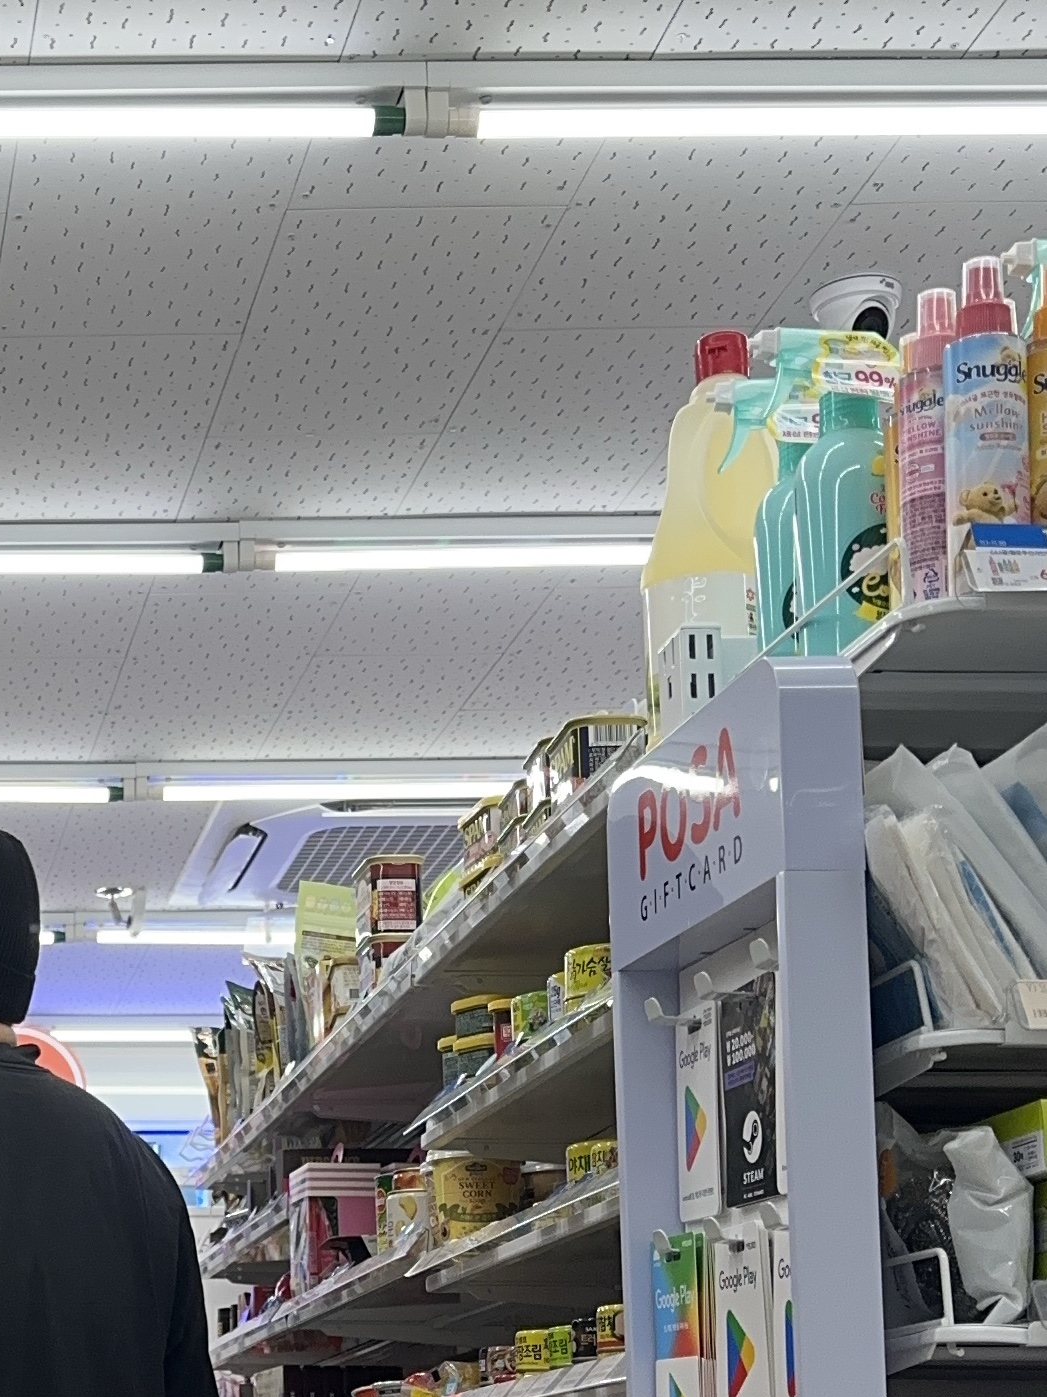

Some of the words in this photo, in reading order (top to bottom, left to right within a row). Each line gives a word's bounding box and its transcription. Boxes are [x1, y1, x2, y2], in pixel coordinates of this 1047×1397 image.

[679, 1049, 699, 1070] Google
[700, 1043, 712, 1066] Play
[458, 1182, 495, 1190] SWEET
[742, 1168, 764, 1184] STEAM
[462, 1189, 492, 1198] CORN
[719, 1271, 742, 1293] Google
[743, 1265, 757, 1290] Play
[655, 1288, 679, 1313] Google
